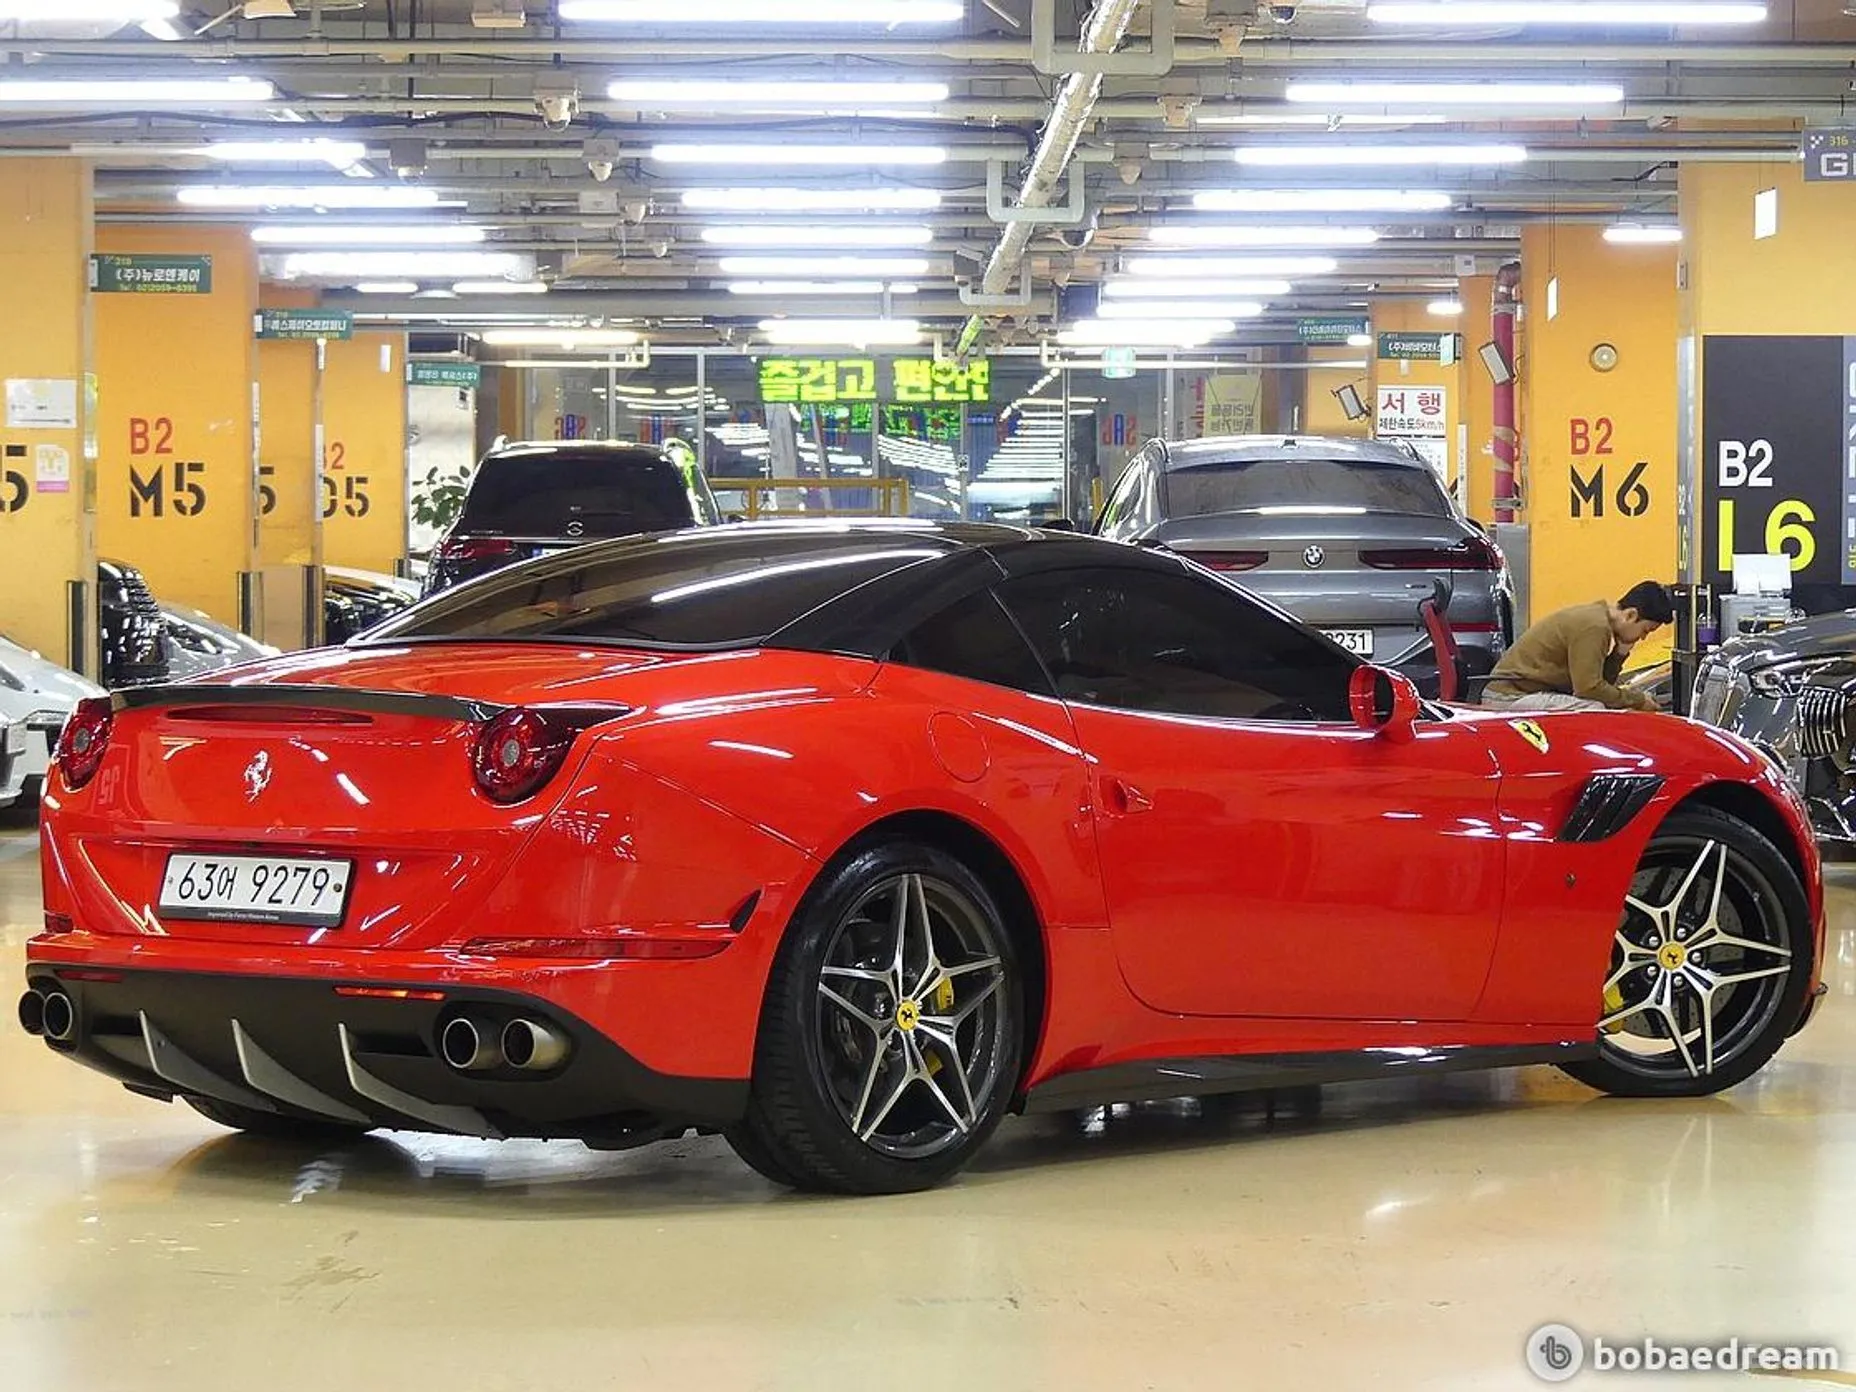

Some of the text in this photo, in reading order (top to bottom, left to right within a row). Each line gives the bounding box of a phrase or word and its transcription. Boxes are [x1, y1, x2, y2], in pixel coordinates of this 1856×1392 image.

[1830, 135, 1848, 146] 316
[1821, 153, 1856, 177] G
[760, 360, 876, 400] 즐겁고
[1382, 392, 1441, 415] 서 행
[130, 417, 173, 454] B2
[1570, 417, 1613, 454] B2
[324, 441, 344, 470] 2
[1718, 439, 1773, 486] B2
[129, 462, 207, 517] M5
[1570, 462, 1649, 517] M6
[178, 862, 330, 906] 63어 9279
